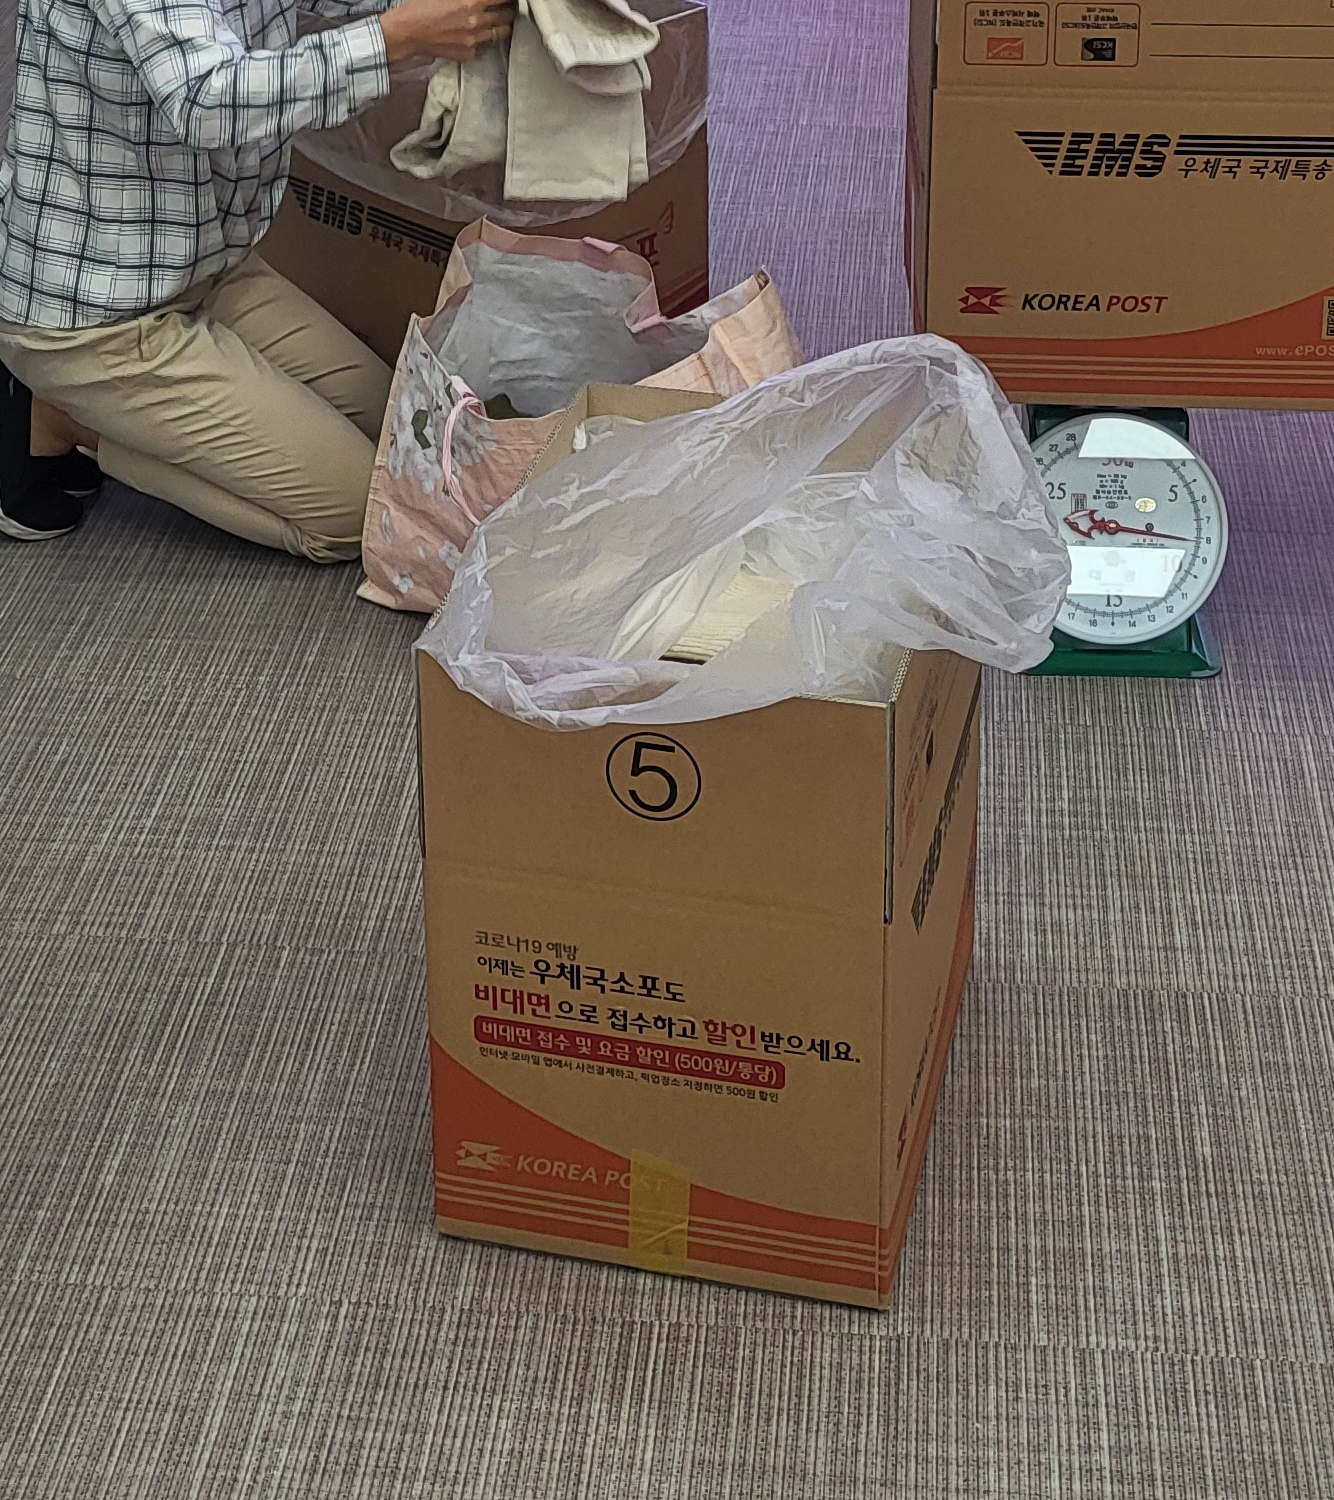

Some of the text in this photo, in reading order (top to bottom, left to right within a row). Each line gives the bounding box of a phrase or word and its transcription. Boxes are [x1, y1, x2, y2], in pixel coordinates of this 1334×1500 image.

[1058, 132, 1171, 178] EMS
[1178, 158, 1334, 181] 우체국 국제특송
[308, 184, 365, 235] EMS
[1021, 293, 1169, 314] KOREA POST
[1045, 482, 1067, 500] 25
[1168, 485, 1179, 502] 5
[474, 931, 579, 960] 코로나19 예방
[477, 956, 685, 1002] 이제는 우체국소포도
[474, 984, 599, 1024] 비대면으로
[607, 1008, 698, 1040] 접수하고
[482, 1021, 777, 1086] 비대면 접수 및 요금 할인 (500원/통당)
[517, 1155, 598, 1184] KOREA
